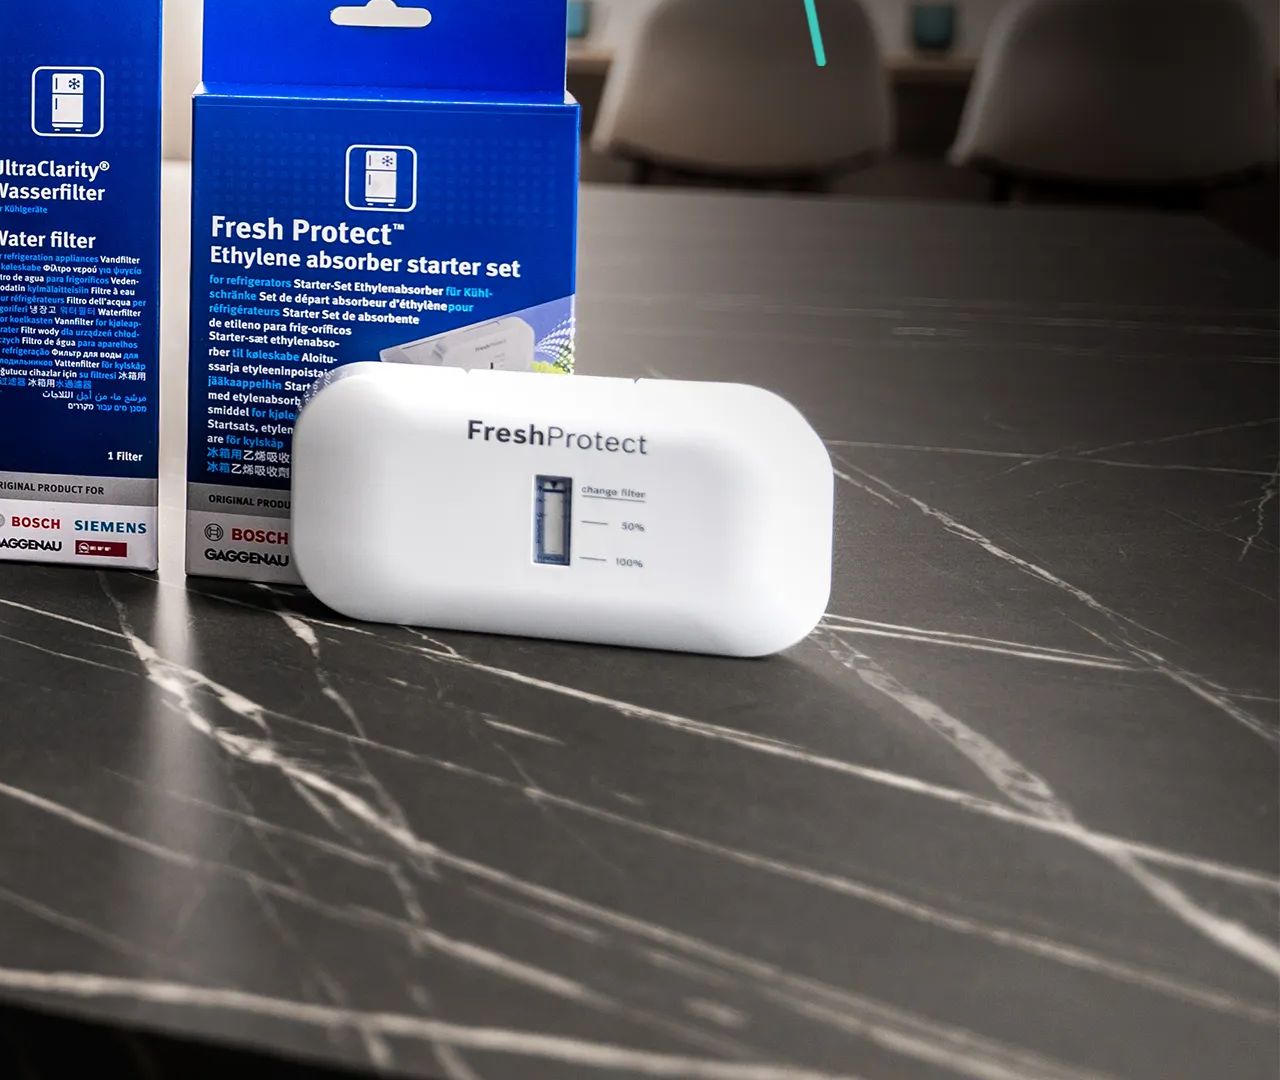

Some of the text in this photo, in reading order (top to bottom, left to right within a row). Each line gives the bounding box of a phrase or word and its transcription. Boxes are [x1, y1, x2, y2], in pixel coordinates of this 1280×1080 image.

[211, 215, 283, 240] Fresh
[50, 230, 96, 249] filter
[210, 245, 521, 278] Ethylene absorber starter set
[209, 274, 493, 298] for refrigerators Starter-Set Ethylenabsorber für Kühl-
[209, 289, 256, 300] schränke
[258, 291, 277, 302] Set
[278, 292, 292, 303] de
[294, 293, 330, 306] départ
[331, 295, 387, 308] absorbeur
[282, 307, 320, 319] Starter
[321, 309, 340, 320] Set
[341, 310, 356, 321] de
[357, 311, 420, 325] absorbente
[208, 317, 352, 336] de etileno para frig-oríficos
[208, 330, 340, 348] Starter-sæt ethylenabso-
[208, 346, 338, 364] rber til køleskabe Aloitu-
[207, 362, 240, 374] ssarja
[207, 375, 311, 392] jääkaappeihin Start
[207, 390, 301, 406] med etylenabsorb
[207, 405, 297, 421] smiddel for kjøle
[207, 418, 294, 436] Startsats, etylen
[207, 434, 283, 450] are för kylskåp
[467, 419, 647, 455] FreshProtect
[107, 451, 143, 462] 1 Filter
[207, 446, 290, 464] 冰箱用乙烯吸收
[37, 483, 83, 494] PRODUCT
[85, 485, 104, 495] FOR
[581, 485, 645, 498] change filter
[208, 494, 291, 510] ORIGINAL PRODU
[11, 516, 60, 529] BOSCH
[74, 519, 147, 534] SIEMENS
[231, 527, 289, 545] BOSCH
[204, 547, 290, 567] GAGGENAU
[615, 557, 643, 568] 100%
